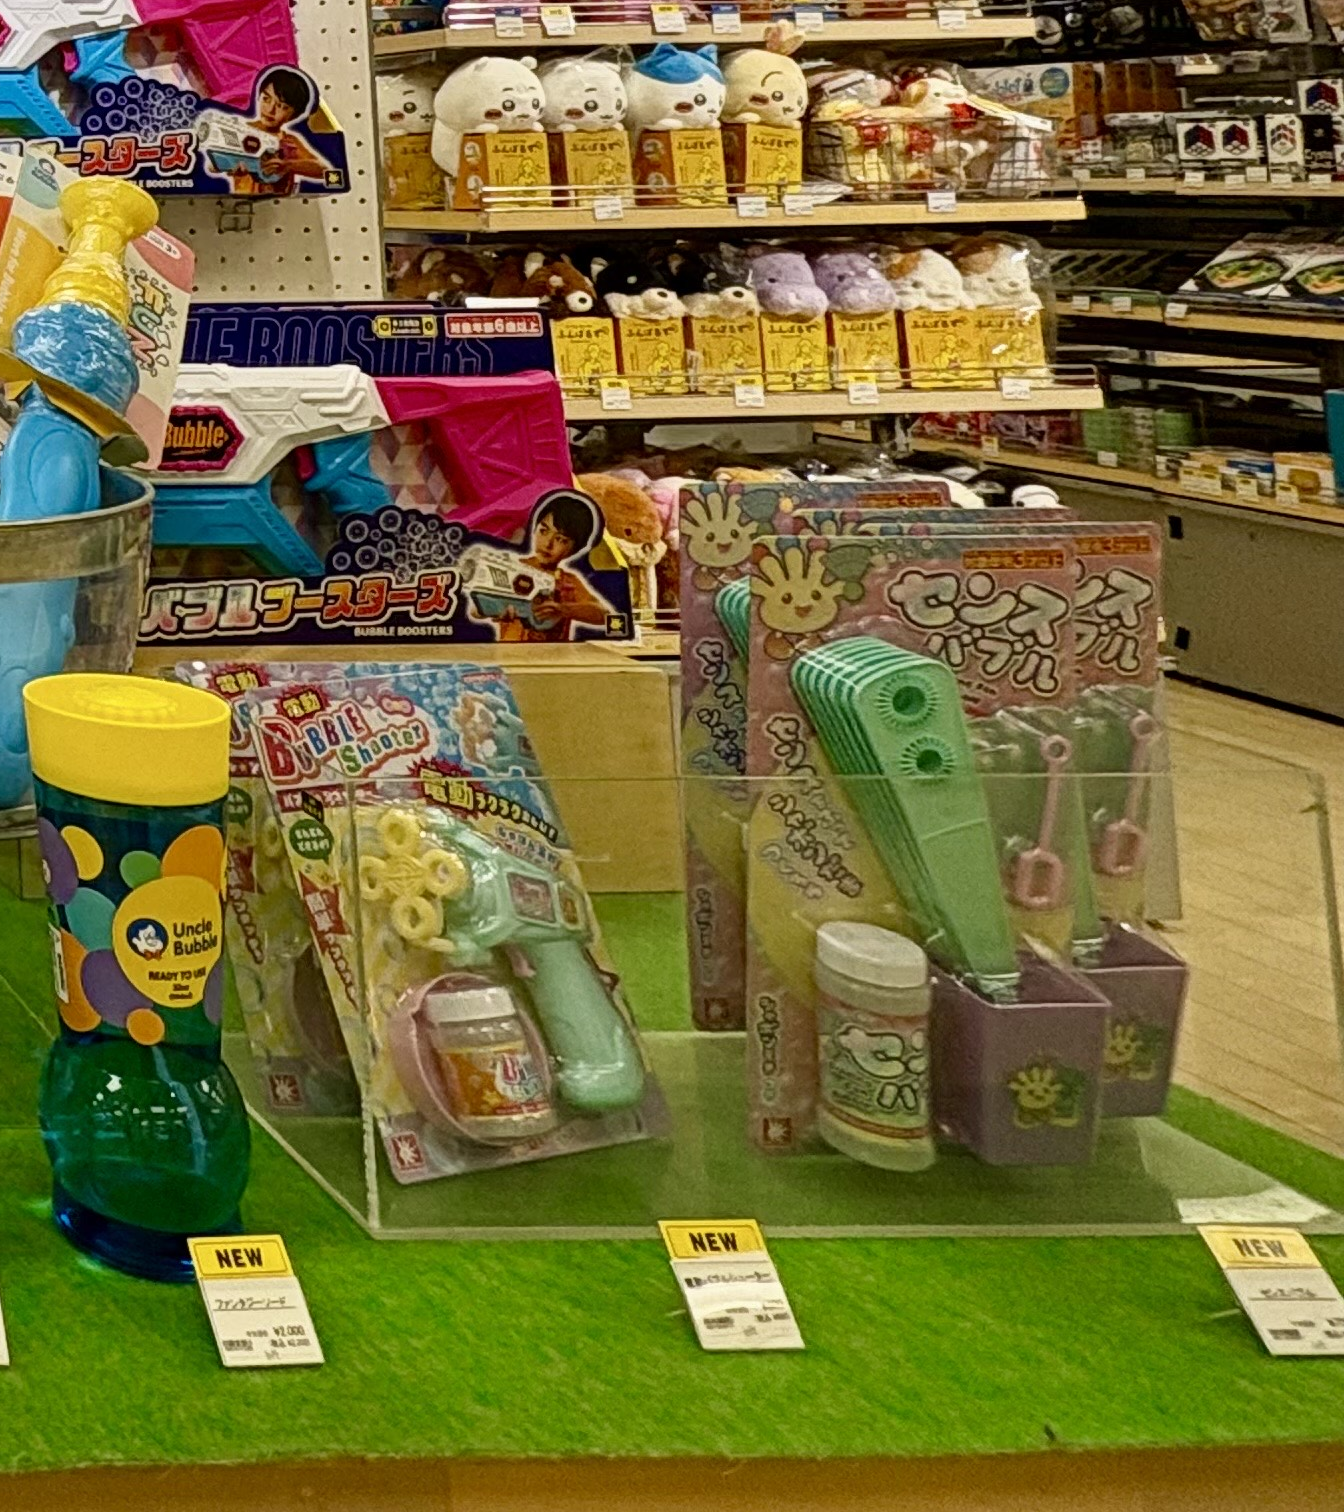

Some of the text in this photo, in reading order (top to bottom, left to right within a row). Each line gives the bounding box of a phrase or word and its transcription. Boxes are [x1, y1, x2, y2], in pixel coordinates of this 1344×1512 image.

[128, 276, 166, 368] FUN
[887, 569, 1070, 648] センス
[397, 625, 454, 637] BOOSTERS
[173, 918, 213, 938] Uncle
[689, 1232, 739, 1252] NEW
[1232, 1238, 1288, 1258] NEW
[215, 1247, 263, 1269] NEW
